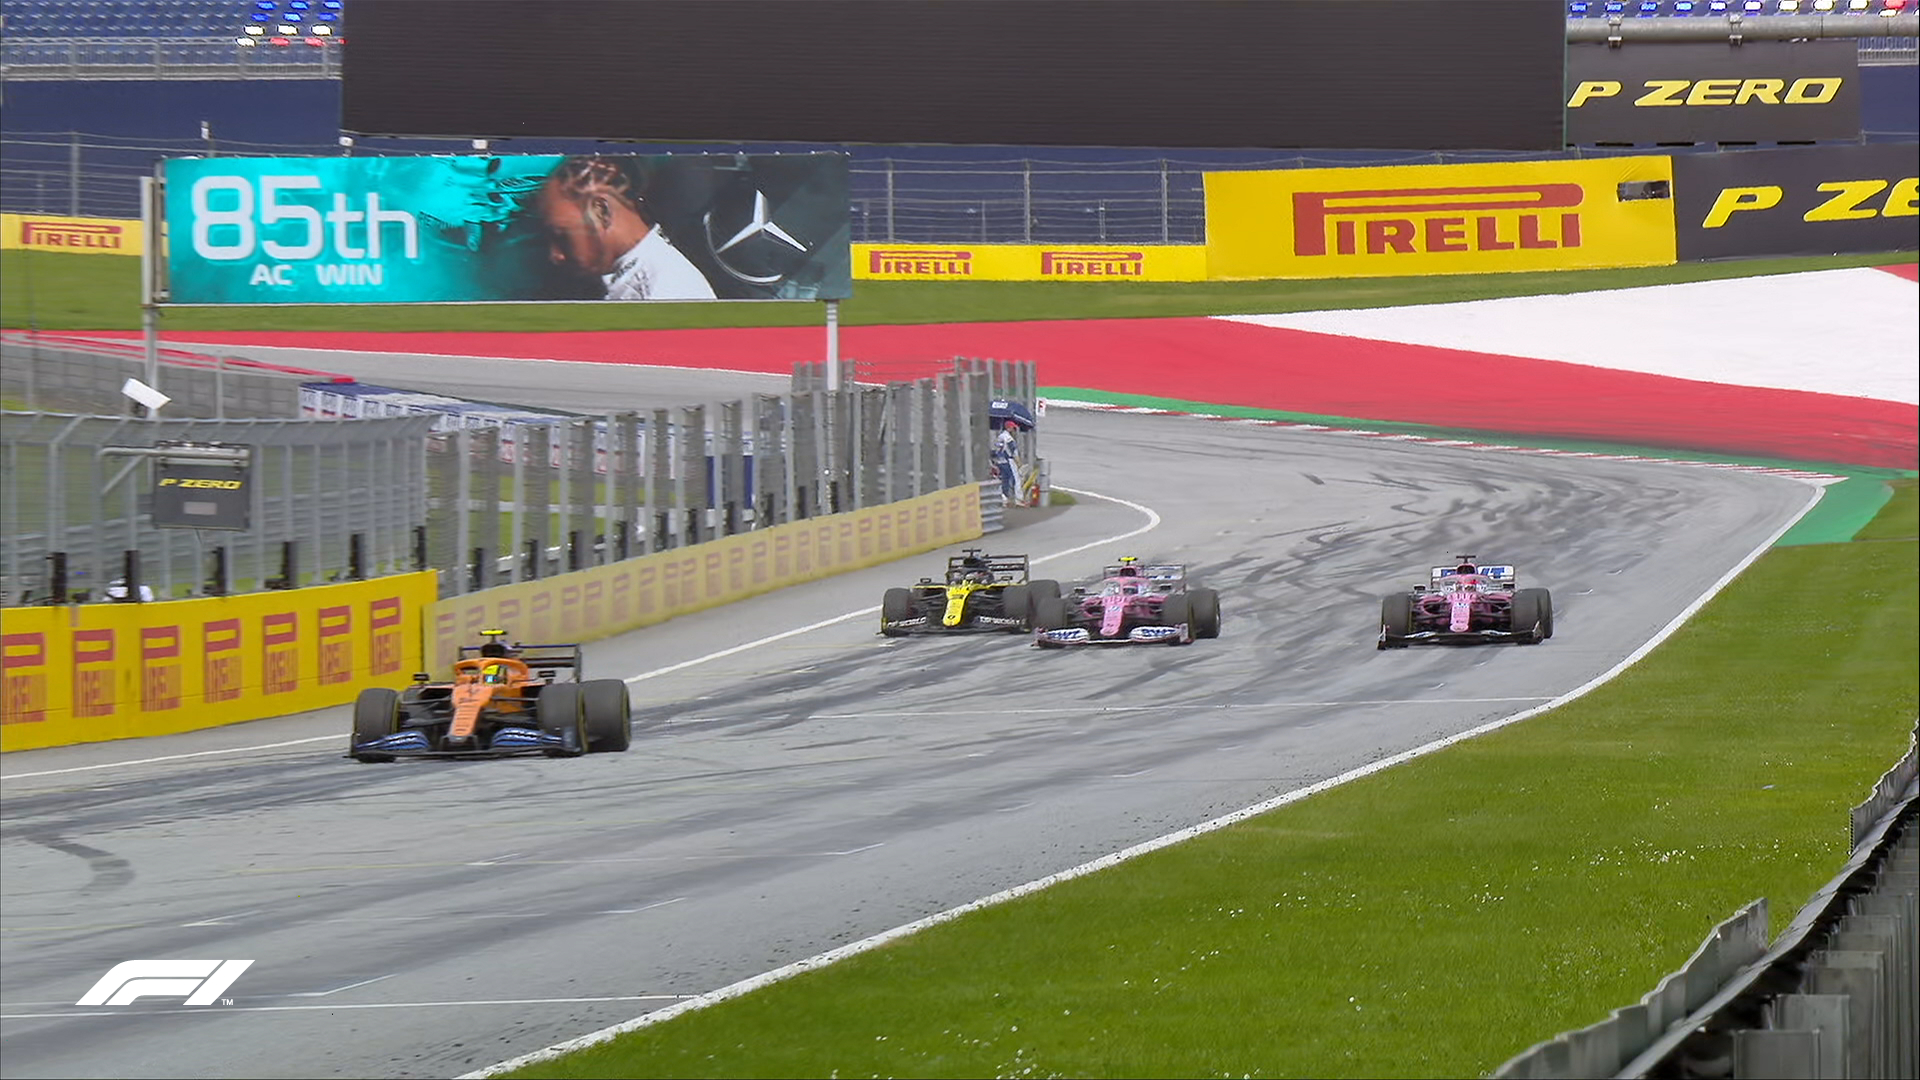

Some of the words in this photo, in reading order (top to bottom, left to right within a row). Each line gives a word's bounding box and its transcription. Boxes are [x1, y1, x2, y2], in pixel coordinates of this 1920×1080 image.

[1567, 81, 1622, 107] P
[1634, 77, 1843, 107] ZERO
[191, 175, 418, 259] 85th
[1293, 183, 1584, 256] PIRELLI
[1702, 185, 1783, 228] P
[22, 221, 123, 249] PIRELLI
[249, 264, 294, 285] AC
[315, 264, 382, 285] WIN
[869, 250, 972, 275] PIRELLI
[1041, 252, 1144, 276] PIRELLI
[158, 478, 178, 487] P
[178, 479, 242, 490] ZERO
